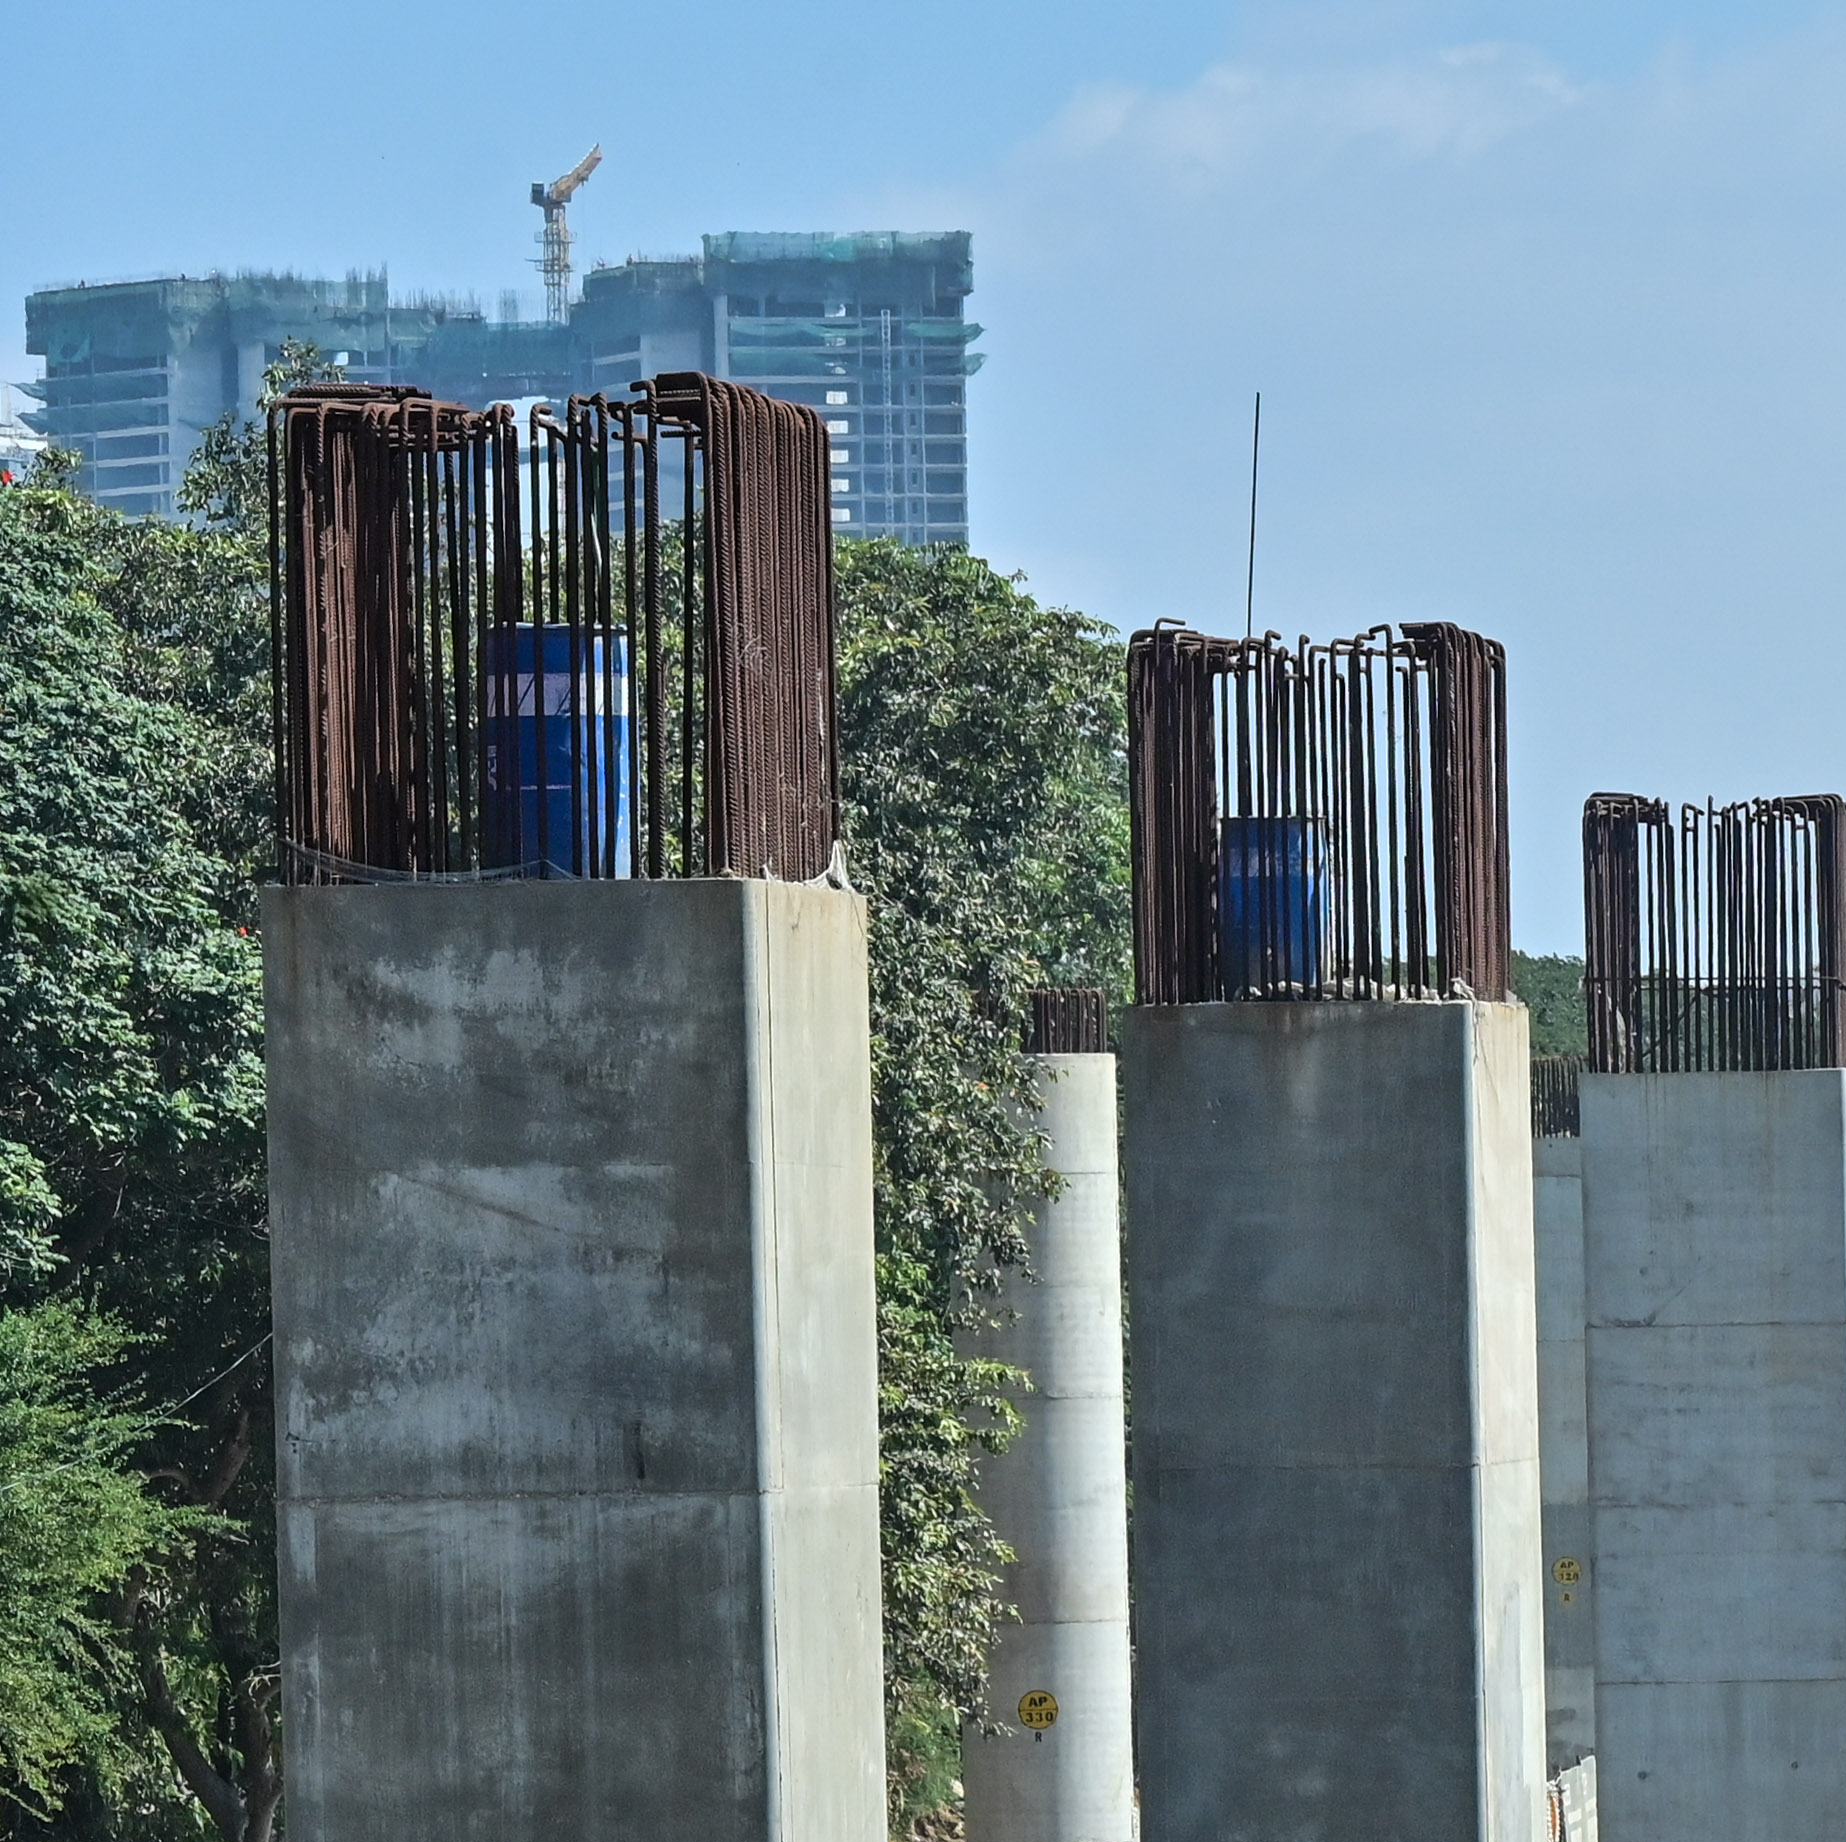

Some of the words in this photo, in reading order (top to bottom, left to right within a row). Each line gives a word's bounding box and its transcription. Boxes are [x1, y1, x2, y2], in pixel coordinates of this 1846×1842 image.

[1029, 1696, 1048, 1707] AP
[1025, 1712, 1053, 1722] 330
[1035, 1731, 1042, 1742] R
